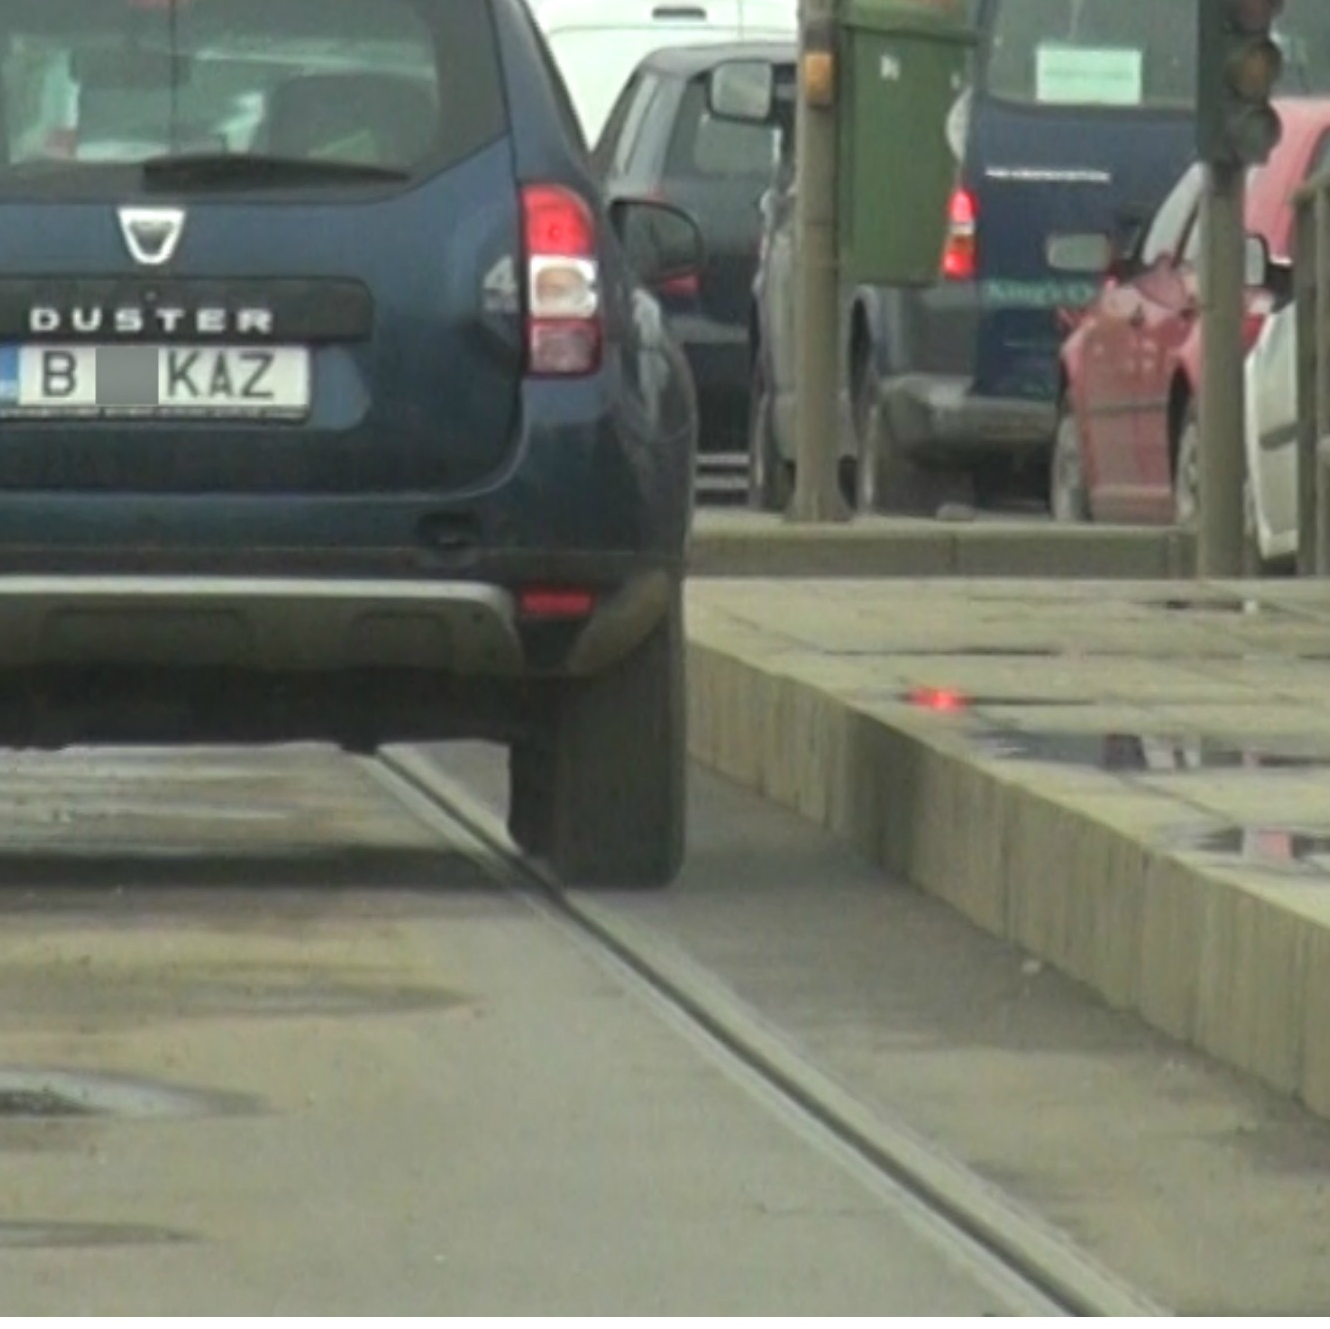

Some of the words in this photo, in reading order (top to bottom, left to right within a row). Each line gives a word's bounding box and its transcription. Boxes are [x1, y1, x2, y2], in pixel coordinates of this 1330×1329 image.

[29, 307, 274, 334] DUSTER
[42, 349, 76, 398] B
[166, 349, 275, 398] KAZ
